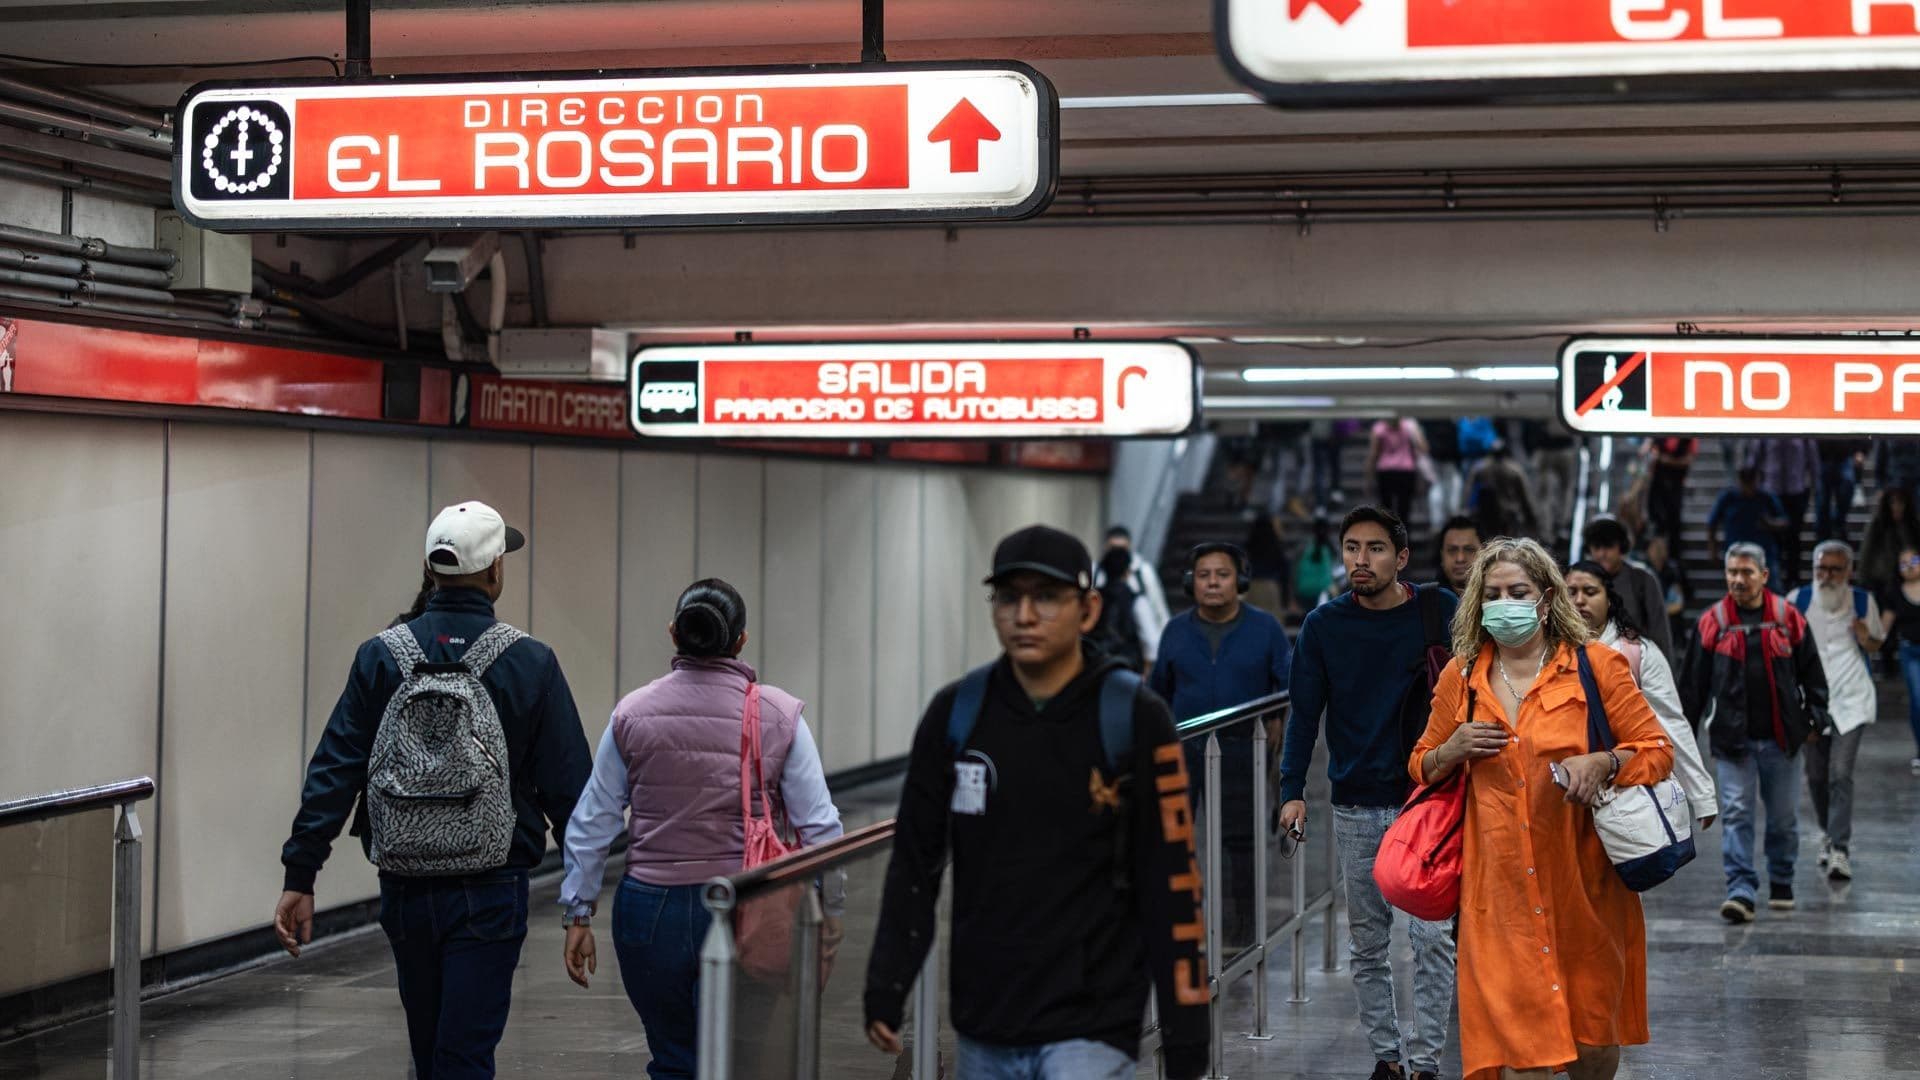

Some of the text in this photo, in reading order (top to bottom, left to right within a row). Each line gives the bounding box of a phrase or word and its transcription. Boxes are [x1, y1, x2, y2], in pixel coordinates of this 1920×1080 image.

[1610, 0, 1784, 40] EL
[463, 92, 765, 129] DIRECCION
[327, 123, 870, 193] EL ROSARIO
[817, 361, 987, 395] SALIDA
[1683, 360, 1792, 412] NO
[480, 383, 558, 425] MARTIN
[714, 397, 1098, 421] PARADERO DE AUTOBUSES
